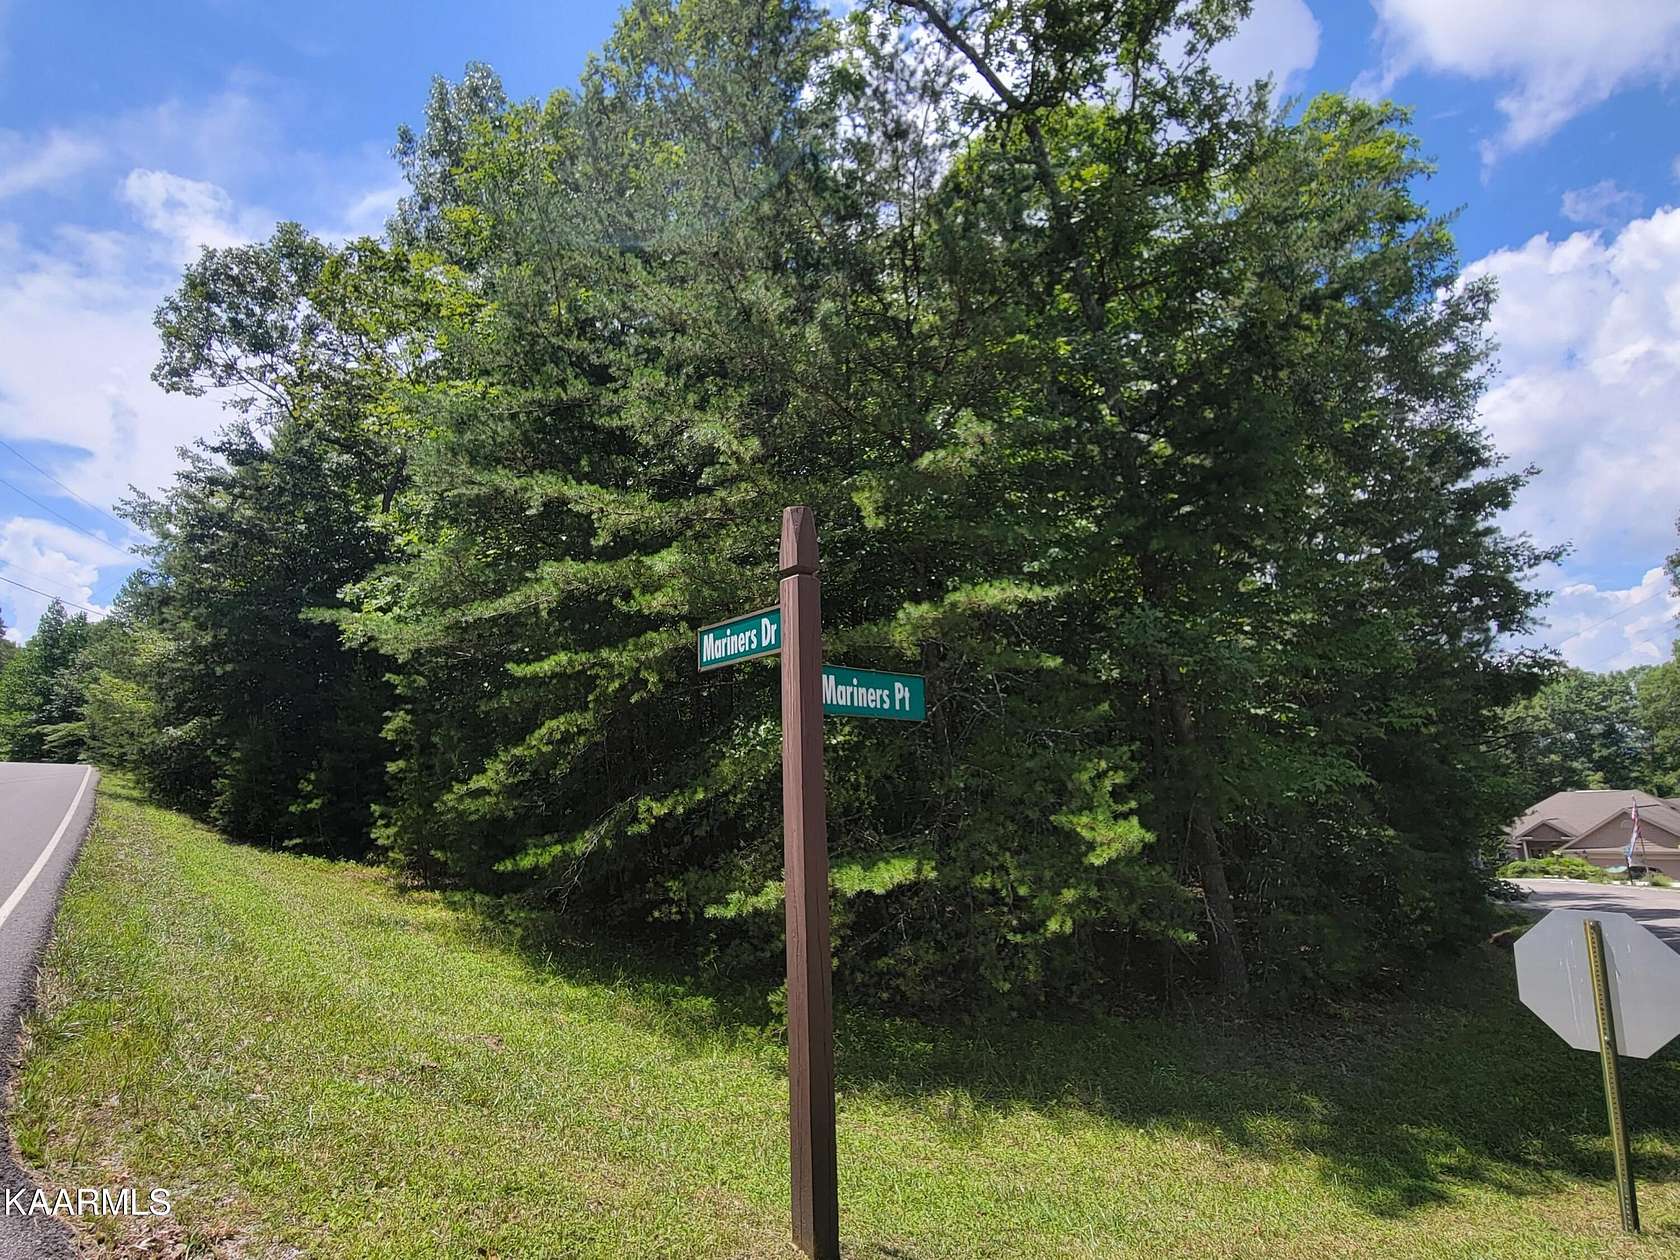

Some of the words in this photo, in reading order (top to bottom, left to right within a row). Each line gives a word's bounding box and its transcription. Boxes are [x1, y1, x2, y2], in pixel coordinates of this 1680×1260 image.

[702, 628, 757, 662] Mariners
[761, 617, 777, 647] Dr
[822, 674, 890, 710] Mariners
[894, 681, 910, 711] Pt
